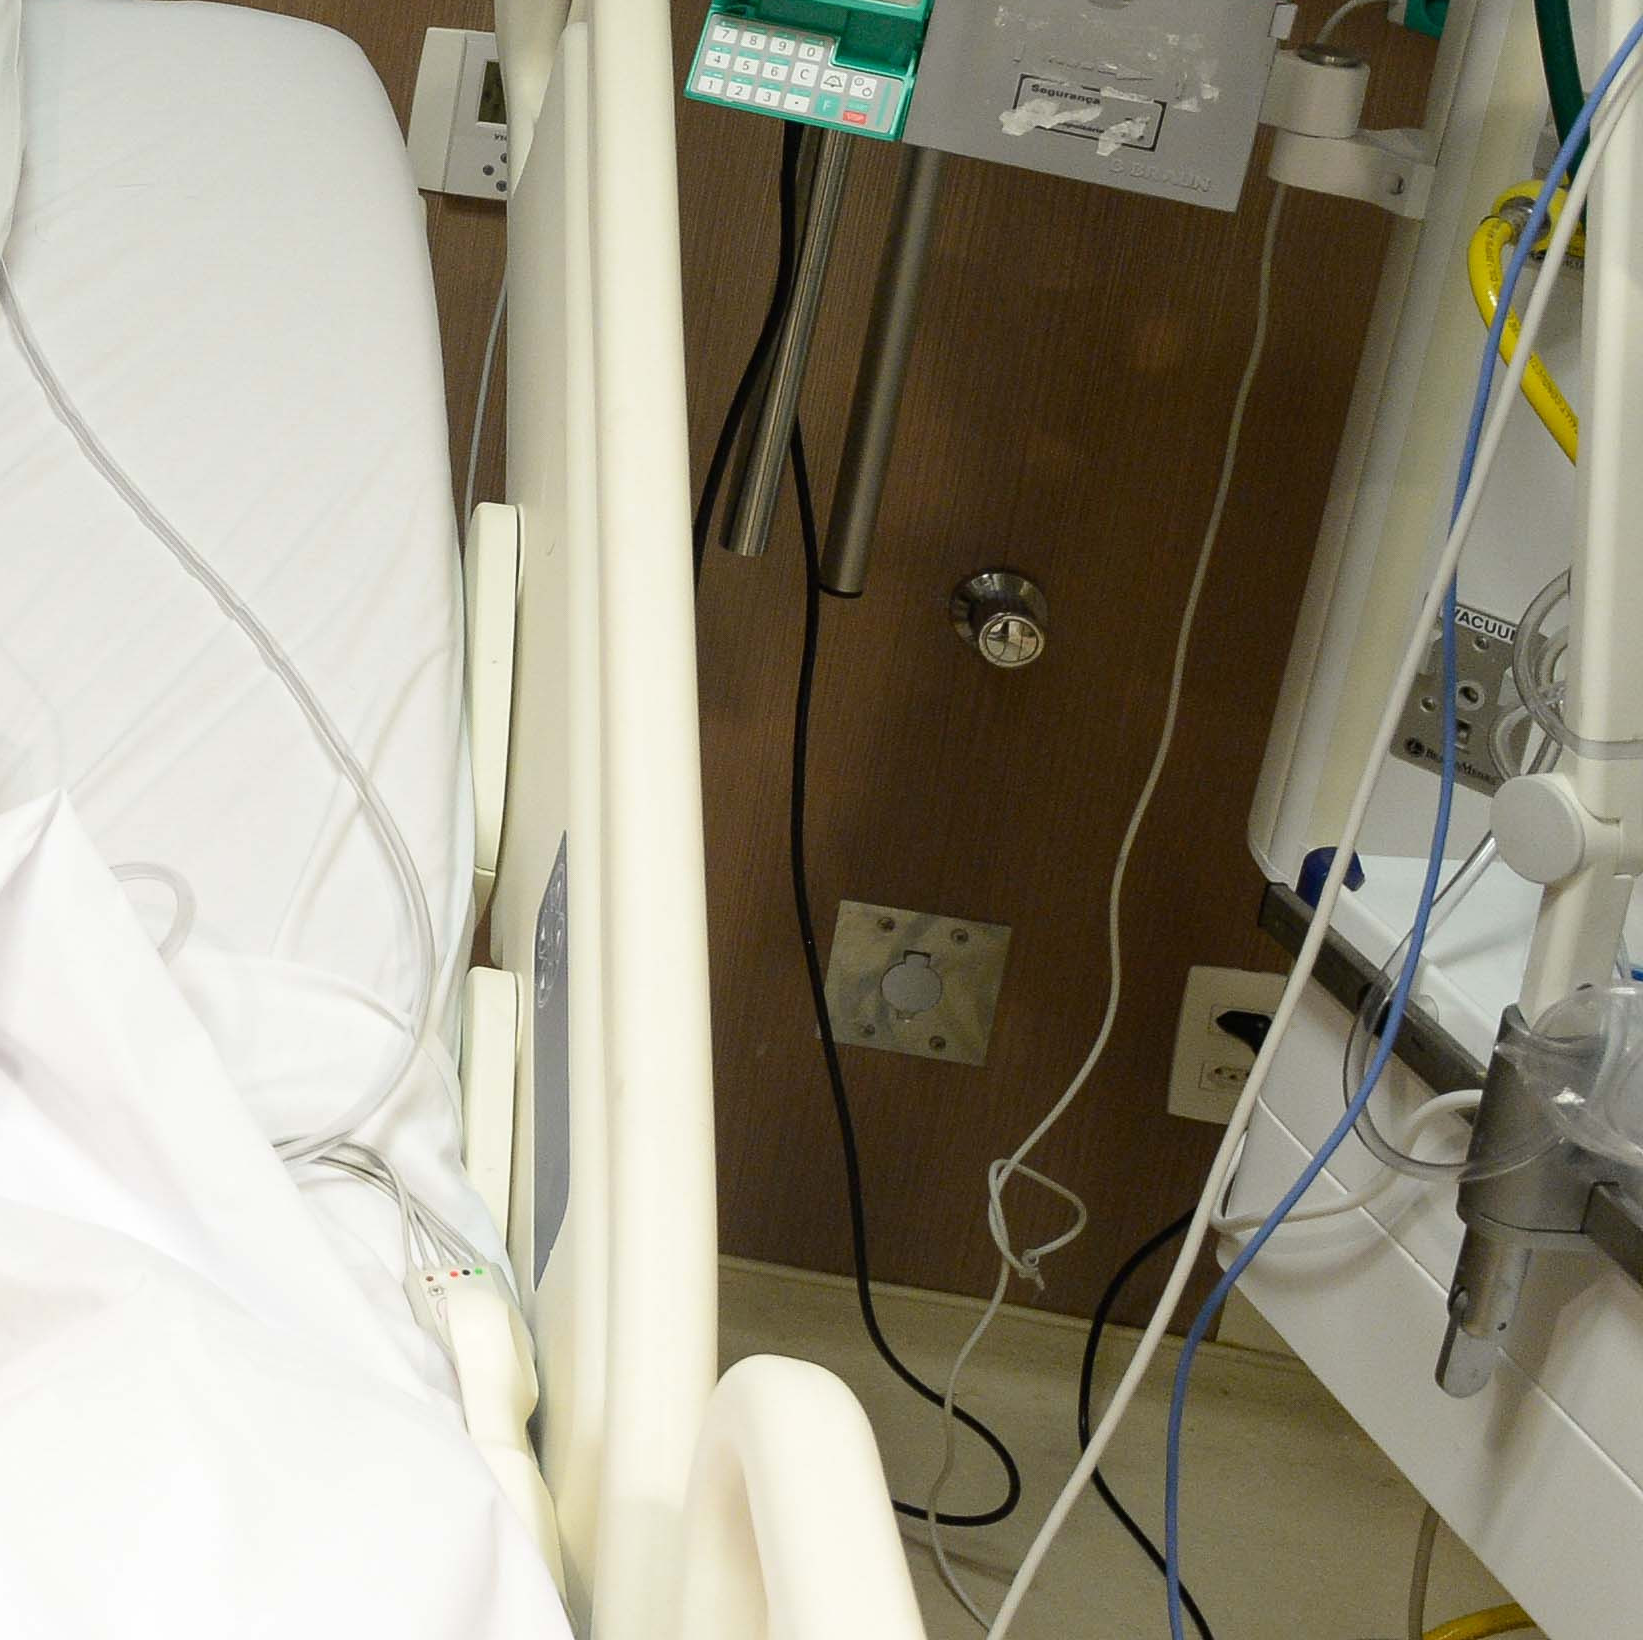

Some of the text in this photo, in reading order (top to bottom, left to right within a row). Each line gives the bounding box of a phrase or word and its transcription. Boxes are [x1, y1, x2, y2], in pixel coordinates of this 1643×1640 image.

[749, 35, 757, 46] 8
[778, 40, 786, 51] 9
[742, 60, 750, 71] 5
[770, 66, 778, 77] 6
[799, 68, 809, 80] C
[734, 85, 743, 96] 2
[763, 91, 771, 102] 3
[1031, 83, 1101, 105] Segurança
